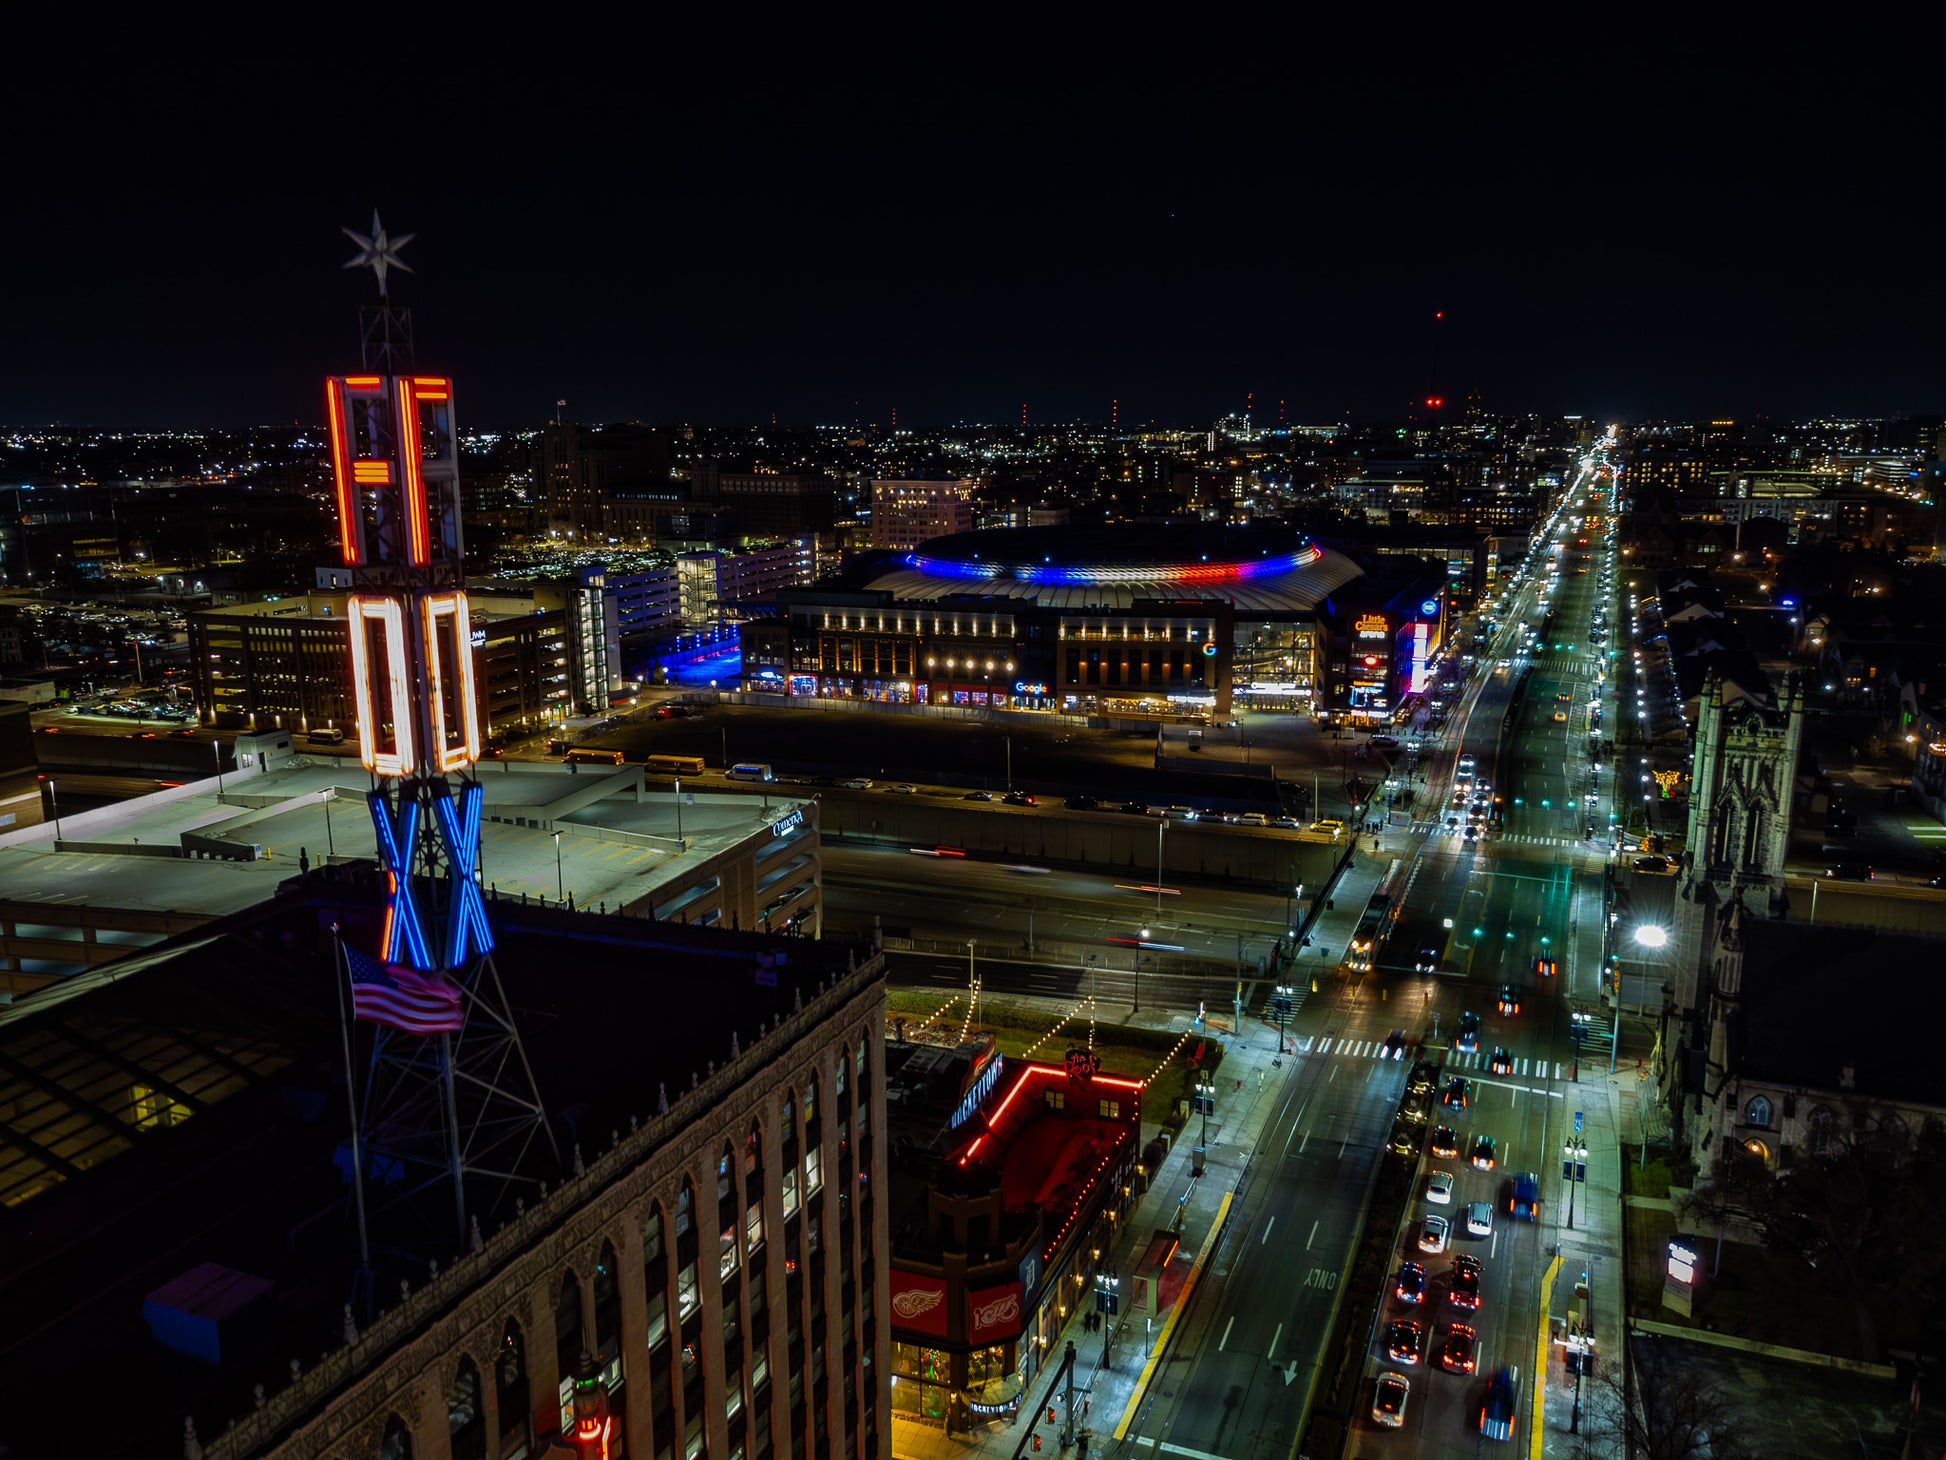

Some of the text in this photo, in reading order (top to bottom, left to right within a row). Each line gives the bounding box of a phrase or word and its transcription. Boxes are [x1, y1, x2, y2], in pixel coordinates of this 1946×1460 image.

[1362, 614, 1385, 625] Little
[1202, 642, 1218, 657] G
[1016, 682, 1047, 694] Google
[1070, 1053, 1086, 1063] the
[1063, 1055, 1098, 1081] Roof
[951, 1052, 1003, 1130] HOCKEYTOWN
[1304, 1267, 1337, 1291] ONLY
